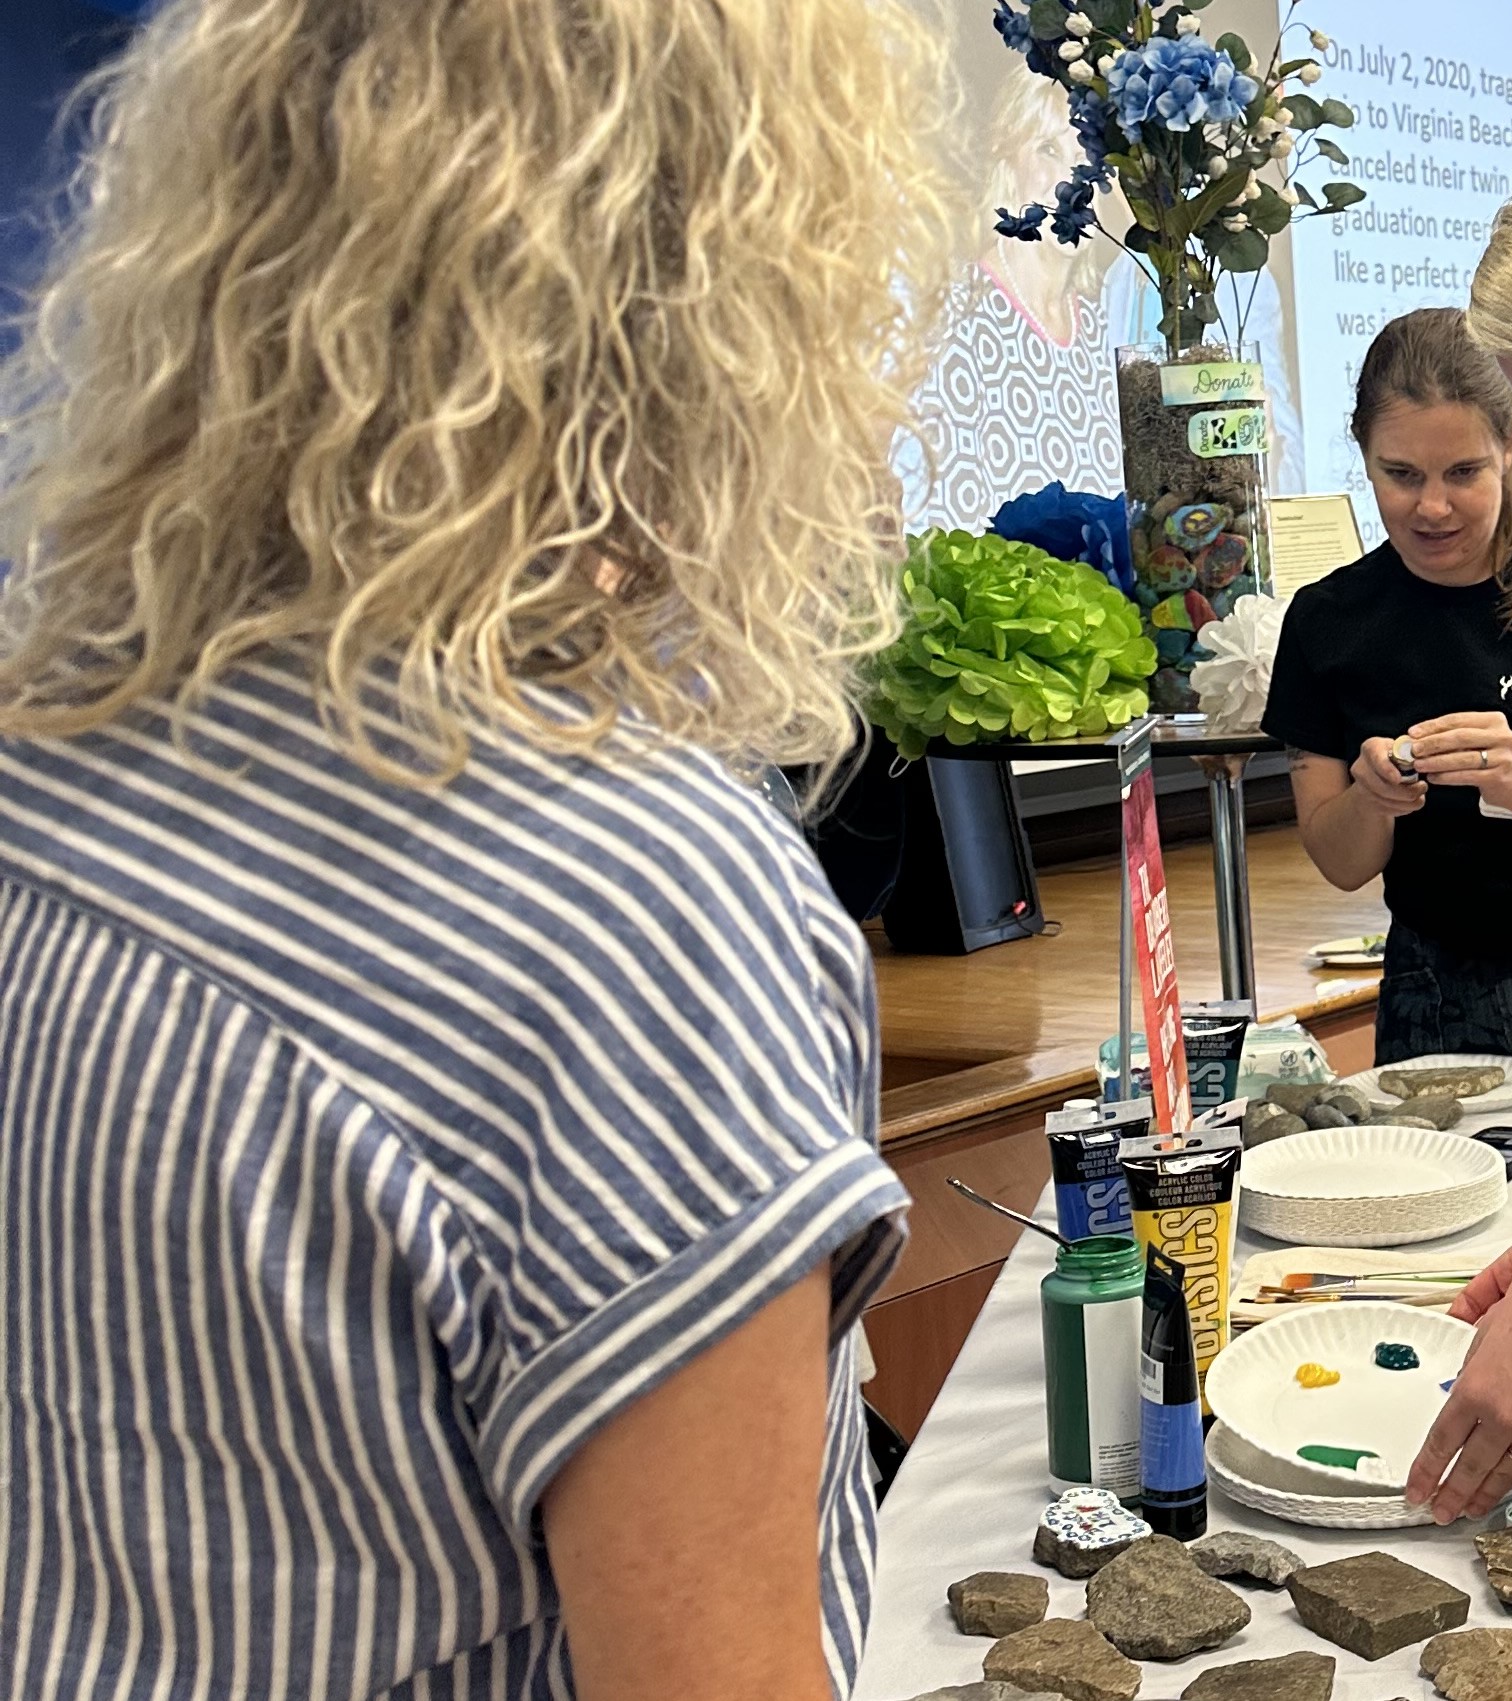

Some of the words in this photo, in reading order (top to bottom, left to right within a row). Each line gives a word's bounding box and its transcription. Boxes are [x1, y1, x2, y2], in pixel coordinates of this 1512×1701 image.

[1323, 38, 1352, 72] On
[1358, 44, 1396, 85] July
[1401, 52, 1419, 89] 2,
[1424, 56, 1475, 98] 2020,
[1367, 99, 1388, 130] to
[1392, 102, 1464, 143] Virginia
[1421, 155, 1466, 190] their
[1470, 165, 1510, 195] twin
[1332, 201, 1438, 236] graduation
[1334, 249, 1368, 283] like
[1374, 262, 1386, 285] a
[1391, 257, 1459, 292] perfect
[1336, 312, 1376, 336] was
[1193, 368, 1254, 394] Donate
[1190, 1173, 1214, 1184] COLOR
[1158, 1195, 1182, 1207] COLOR
